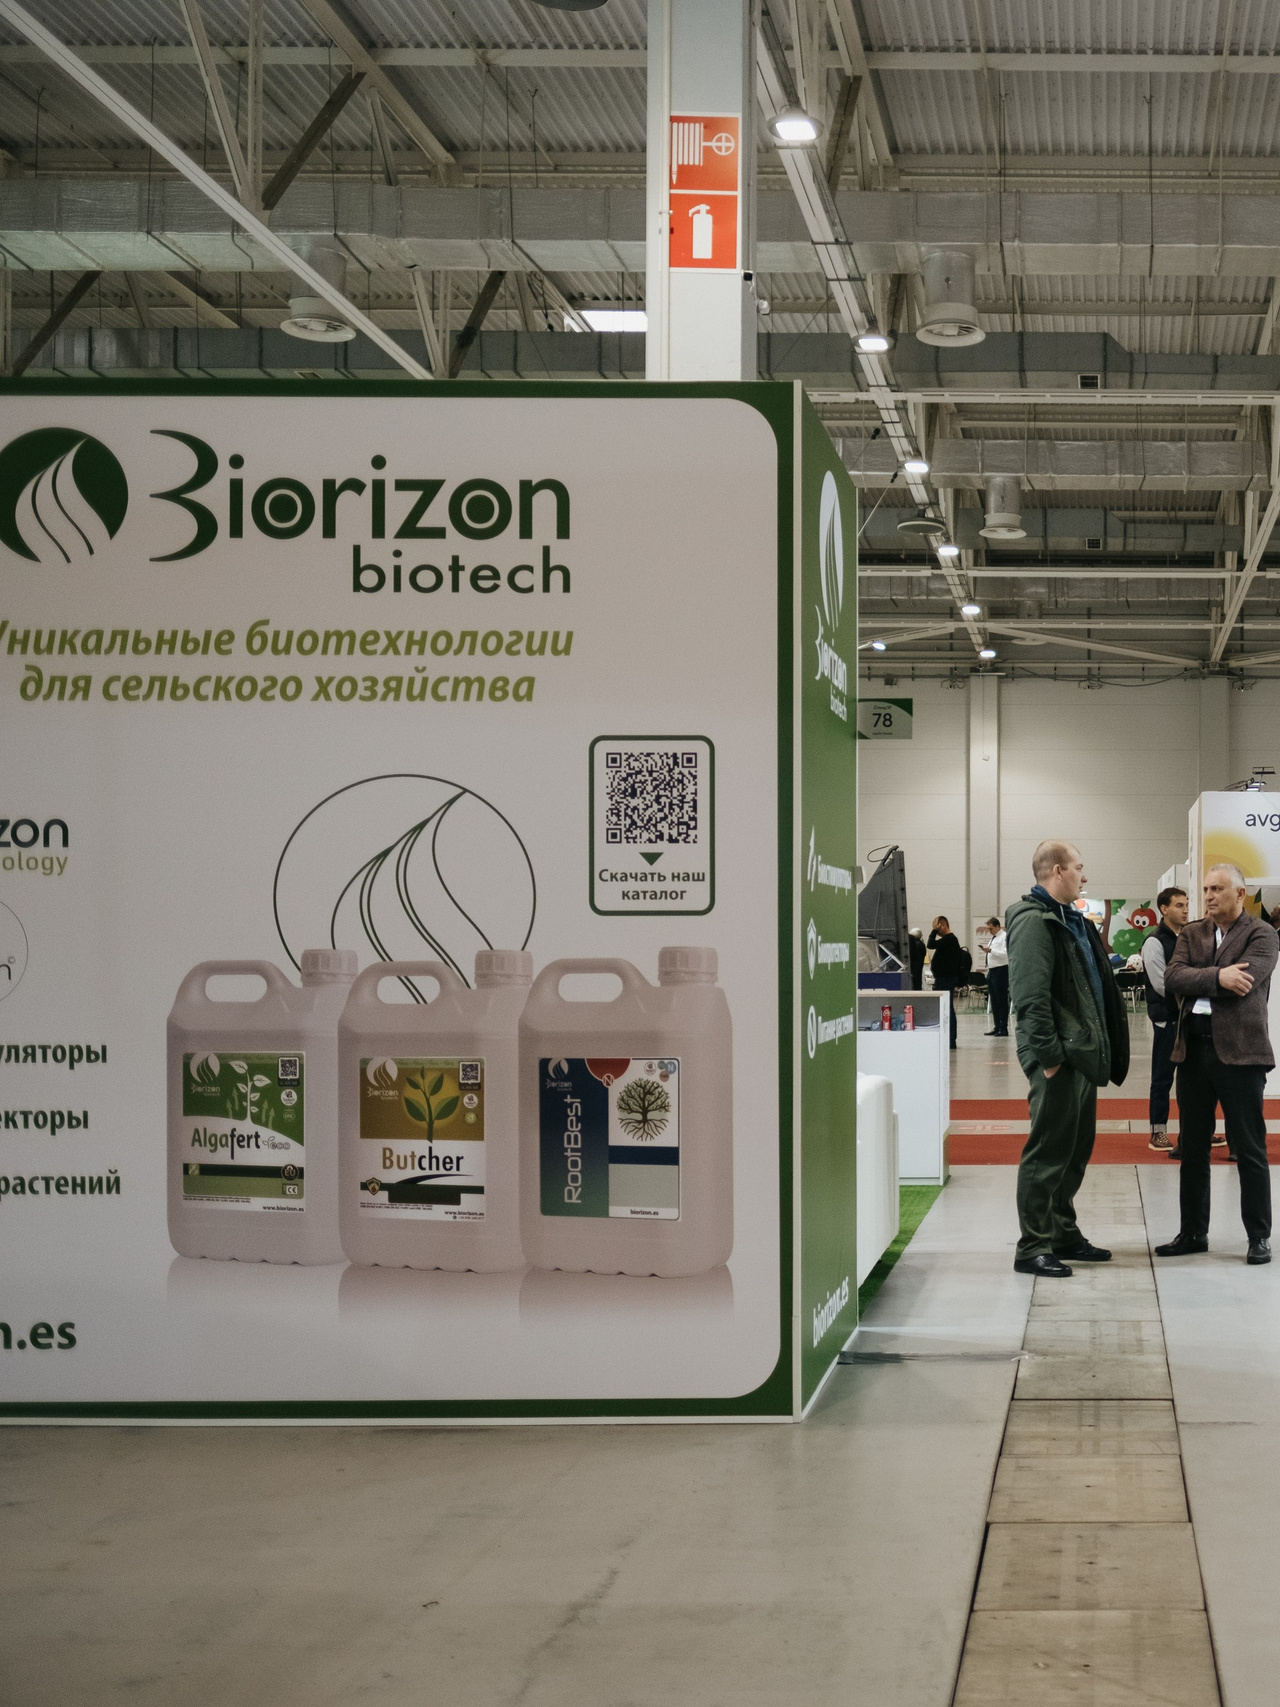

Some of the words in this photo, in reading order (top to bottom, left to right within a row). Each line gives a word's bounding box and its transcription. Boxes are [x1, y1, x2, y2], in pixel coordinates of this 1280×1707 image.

[149, 429, 571, 562] Biorizon
[353, 544, 571, 594] biotech
[246, 619, 574, 656] биотехнологии
[19, 664, 92, 701] для
[102, 674, 303, 702] сельского
[312, 666, 536, 702] хозяйства
[872, 712, 893, 728] 78
[599, 869, 667, 882] Скачать
[671, 872, 706, 882] наш
[622, 890, 687, 901] каталог
[0, 1044, 107, 1070] ляторы
[0, 1110, 89, 1136] кторы
[191, 1127, 261, 1160] Algafert
[564, 1094, 581, 1203] RootBest
[382, 1146, 464, 1171] Butcher
